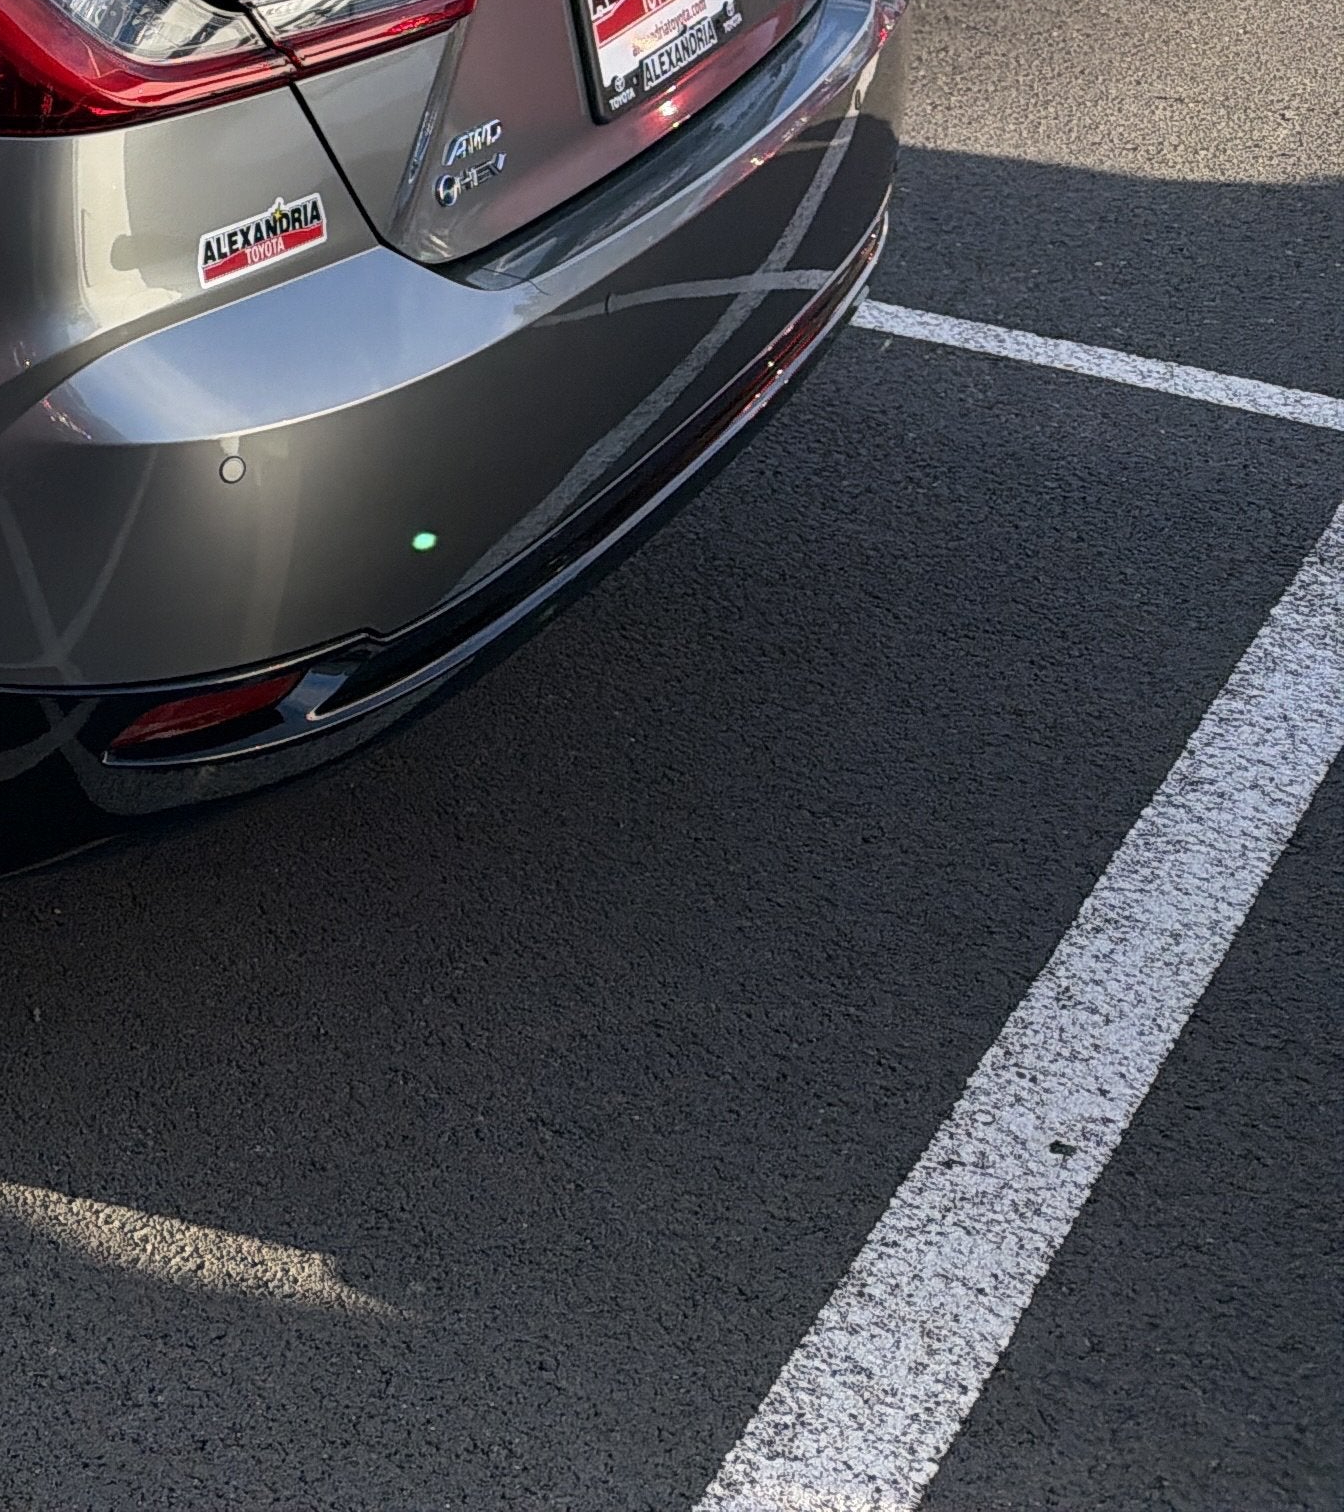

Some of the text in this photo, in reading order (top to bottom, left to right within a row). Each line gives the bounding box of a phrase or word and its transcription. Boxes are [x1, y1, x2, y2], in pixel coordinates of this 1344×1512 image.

[643, 18, 718, 90] ALEXANDRIA
[609, 88, 636, 111] TOYOTA
[442, 118, 502, 166] AWD
[203, 199, 322, 265] ALEXANDRIA
[244, 236, 285, 265] TOYOTA
